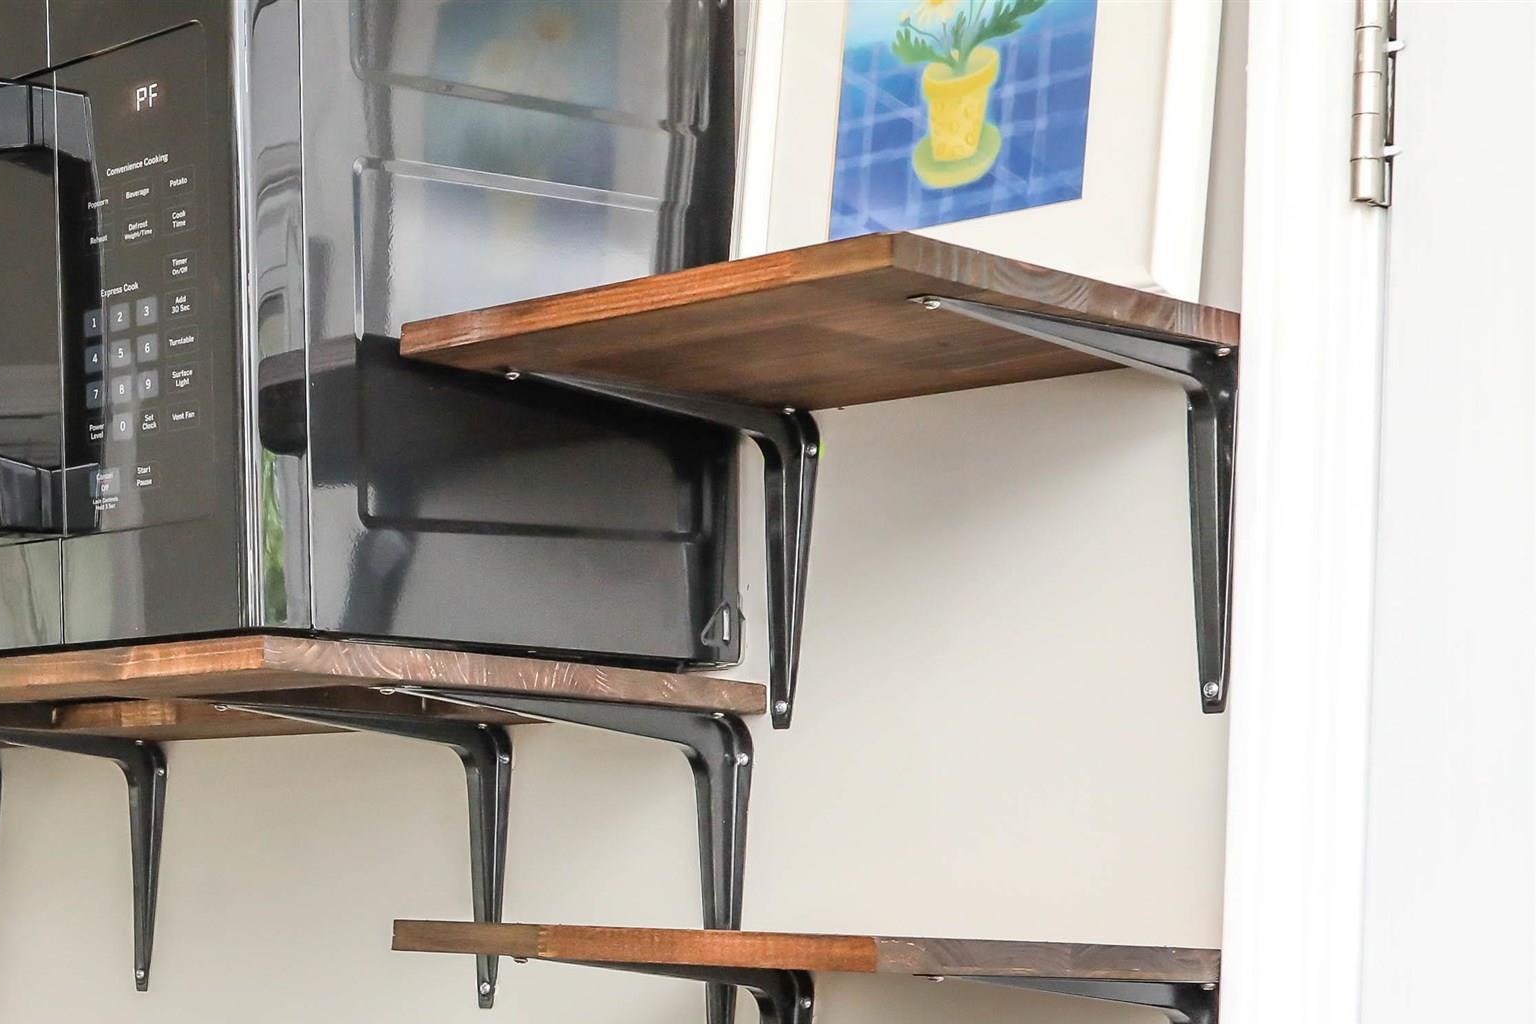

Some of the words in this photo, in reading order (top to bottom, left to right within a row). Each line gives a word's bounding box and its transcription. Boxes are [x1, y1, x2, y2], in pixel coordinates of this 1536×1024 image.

[136, 83, 158, 111] PF
[106, 161, 143, 176] Convenience
[144, 154, 169, 167] Cooking
[170, 178, 188, 187] Potato
[126, 188, 150, 199] Beverage
[172, 210, 186, 220] Cook
[128, 220, 148, 232] Defrost
[173, 220, 186, 229] Time
[172, 258, 188, 267] Timer
[101, 286, 123, 299] Express
[123, 282, 140, 294] Cook
[175, 295, 187, 305] Add
[171, 305, 180, 314] 30
[180, 304, 191, 313] Sec
[92, 318, 97, 329] 1
[117, 312, 123, 323] 2
[144, 306, 150, 317] 3
[169, 335, 195, 347] Turntable
[92, 354, 98, 364] 4
[118, 348, 124, 359] 5
[144, 343, 150, 354] 6
[172, 369, 193, 380] Surface
[176, 377, 190, 389] Light
[94, 389, 99, 400] 7
[119, 384, 125, 395] 8
[145, 379, 152, 390] 9
[145, 414, 154, 422] Set
[172, 411, 185, 422] Vent
[185, 410, 196, 420] Fan
[89, 424, 105, 432] Power
[120, 421, 126, 432] 0
[142, 422, 157, 431] Clock
[91, 431, 104, 440] Level
[137, 466, 151, 475] Start
[137, 479, 153, 487] Pause
